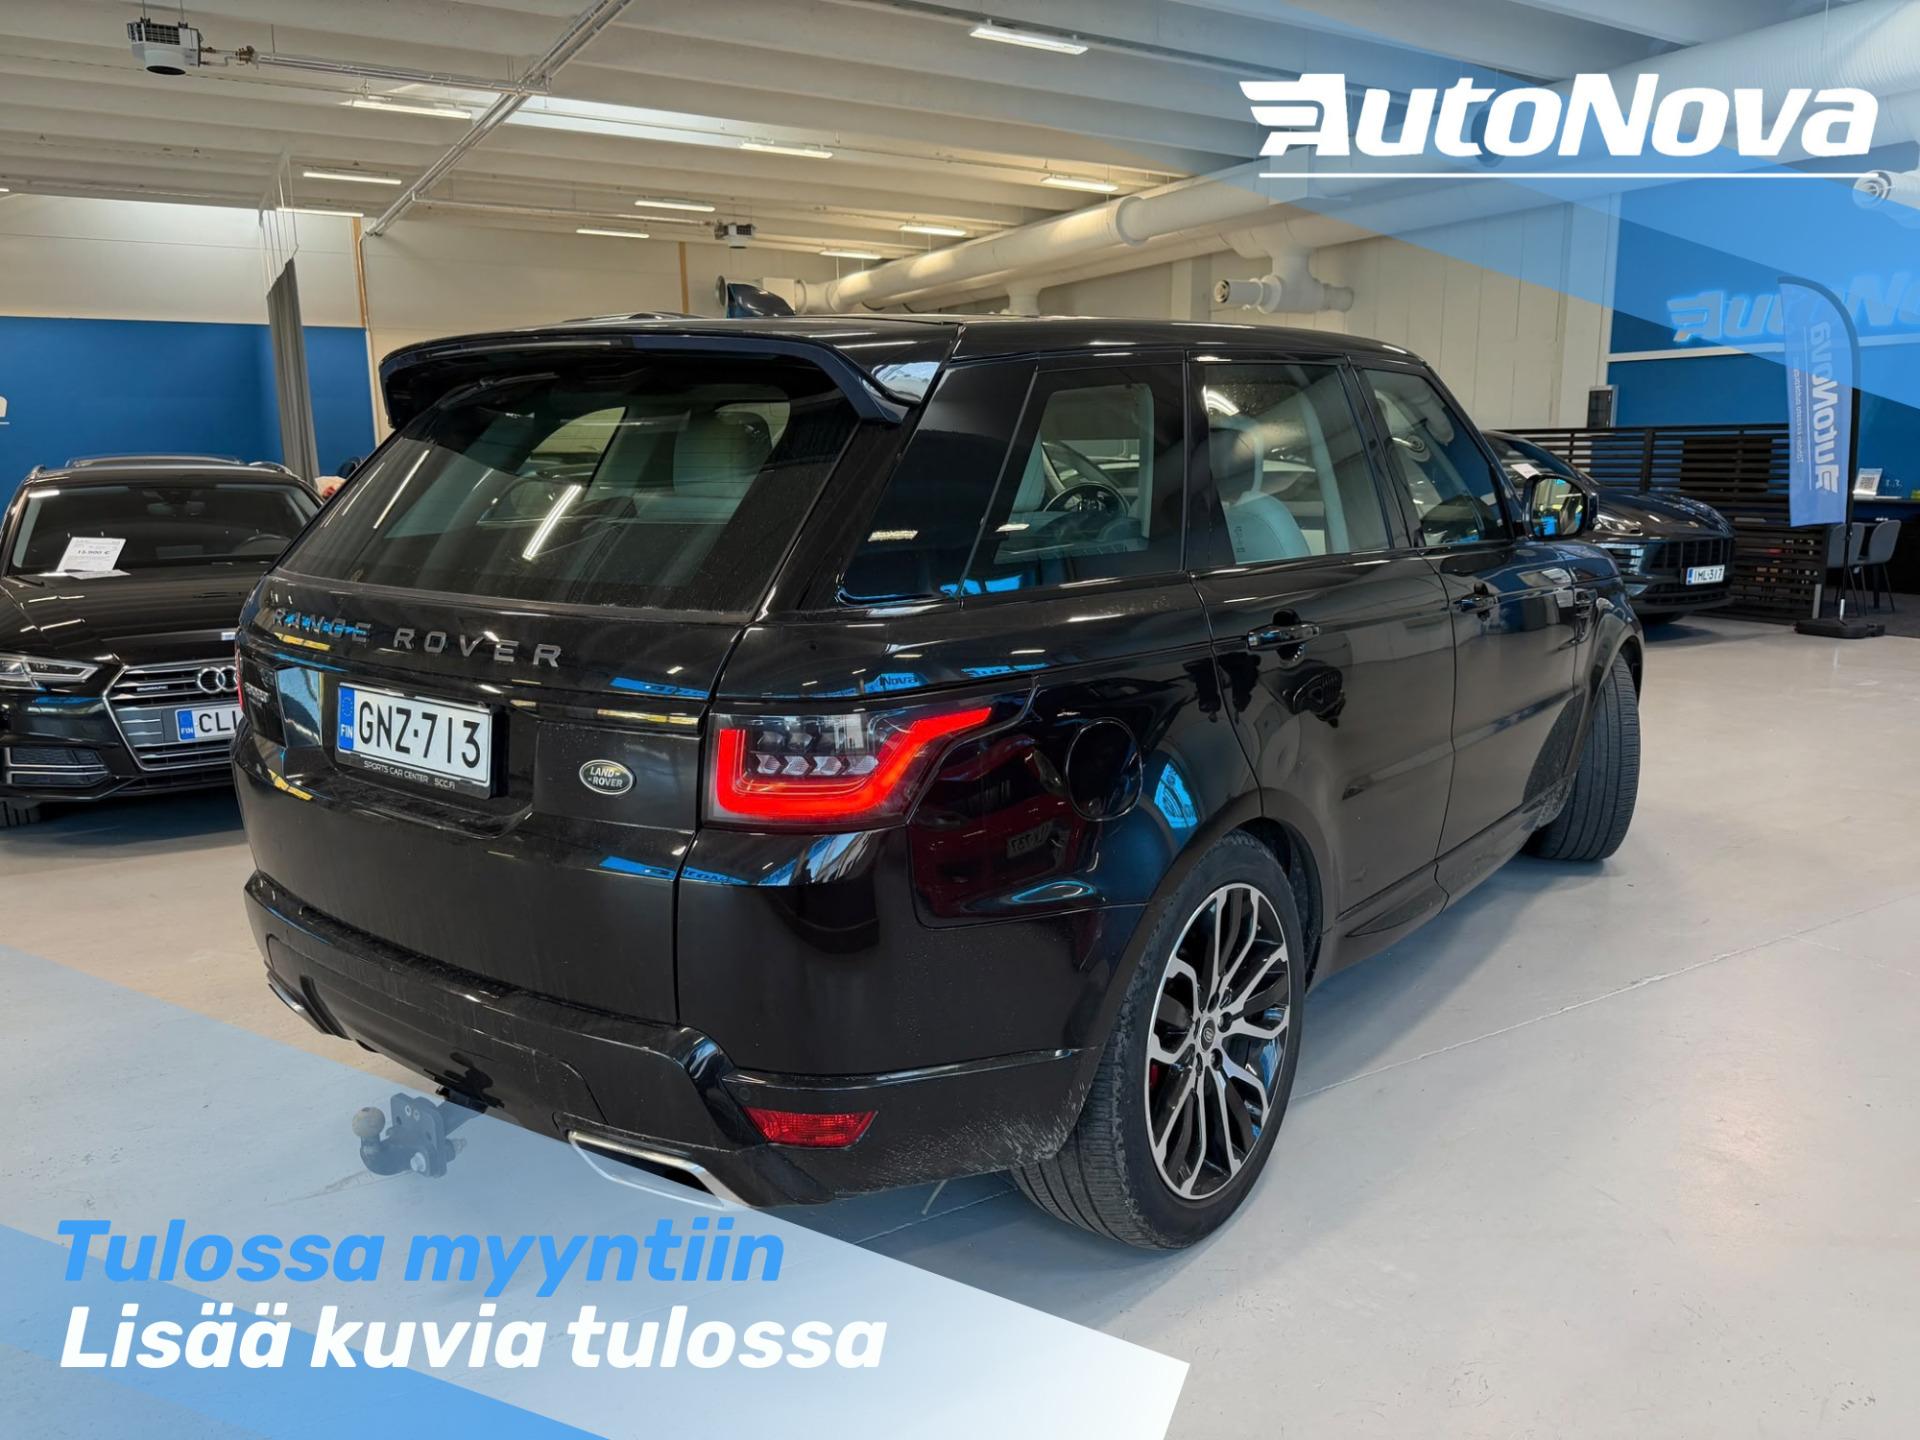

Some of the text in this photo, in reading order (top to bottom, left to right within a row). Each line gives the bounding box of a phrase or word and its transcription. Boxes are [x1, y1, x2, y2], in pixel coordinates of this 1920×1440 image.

[272, 608, 562, 668] RANGE ROVER
[359, 700, 481, 769] GNZ-713
[363, 760, 389, 774] SPORTS
[389, 767, 403, 778] CAR
[404, 770, 429, 784] CENTER
